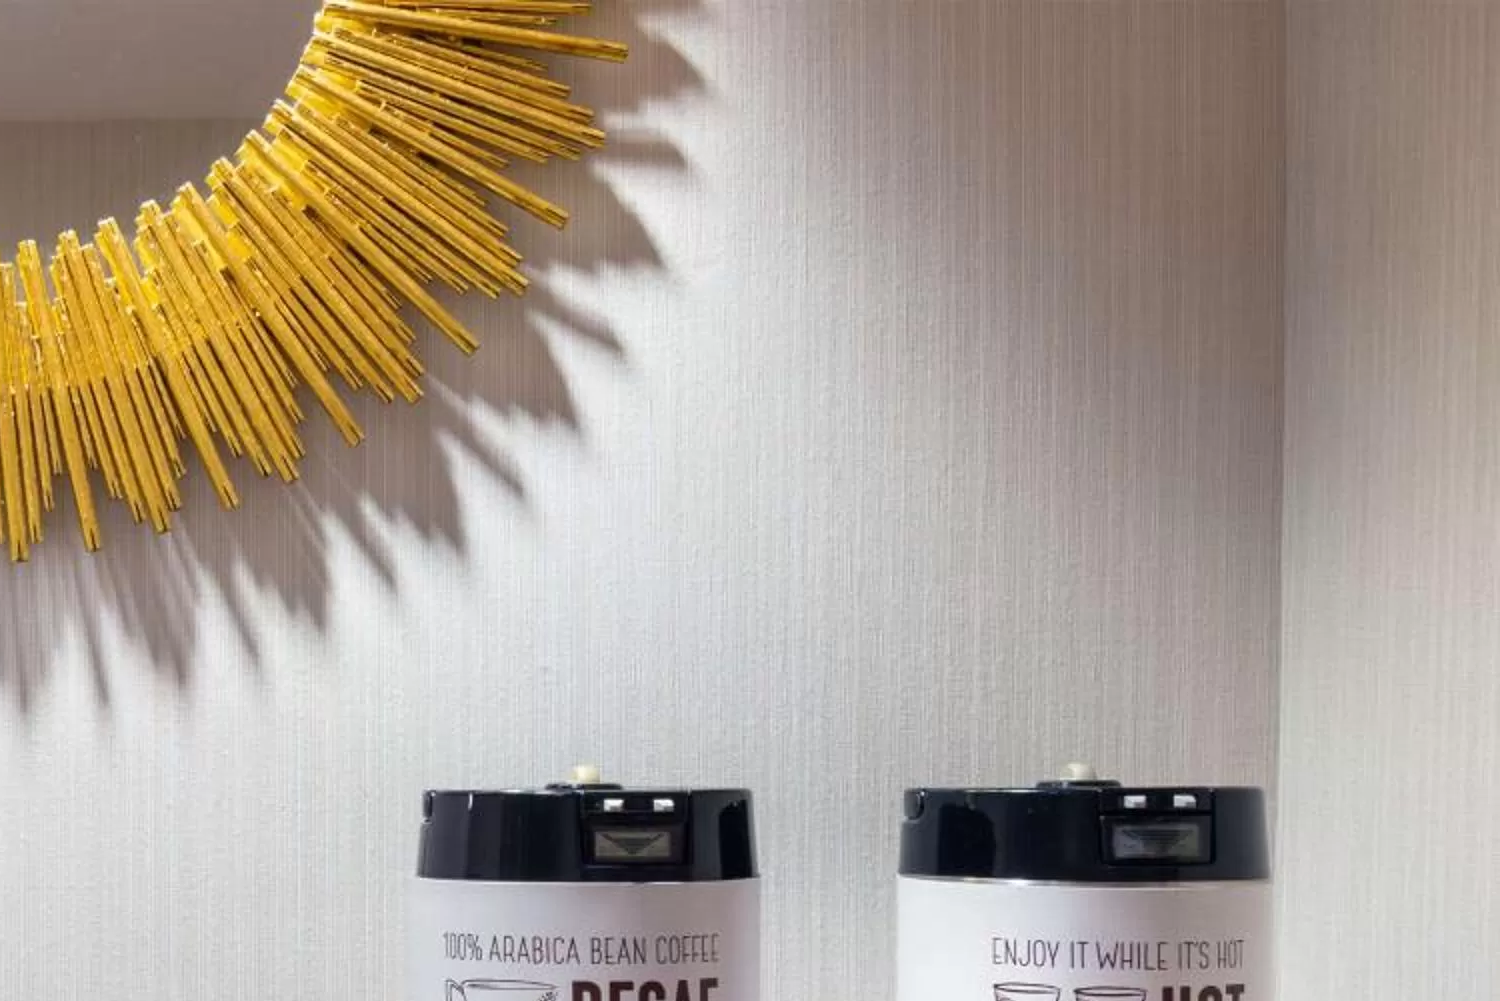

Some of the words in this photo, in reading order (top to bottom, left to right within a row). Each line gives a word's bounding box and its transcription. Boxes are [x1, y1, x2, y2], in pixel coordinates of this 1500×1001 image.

[443, 931, 483, 963] 100%
[488, 934, 581, 965] ARABICA
[591, 935, 647, 965] BEAN
[655, 932, 720, 964] COFFEE
[992, 937, 1060, 968] ENJOY
[1069, 941, 1088, 970] IT
[1096, 941, 1169, 971] WHILE
[1177, 941, 1210, 970] IT'S
[1217, 939, 1244, 969] HOT
